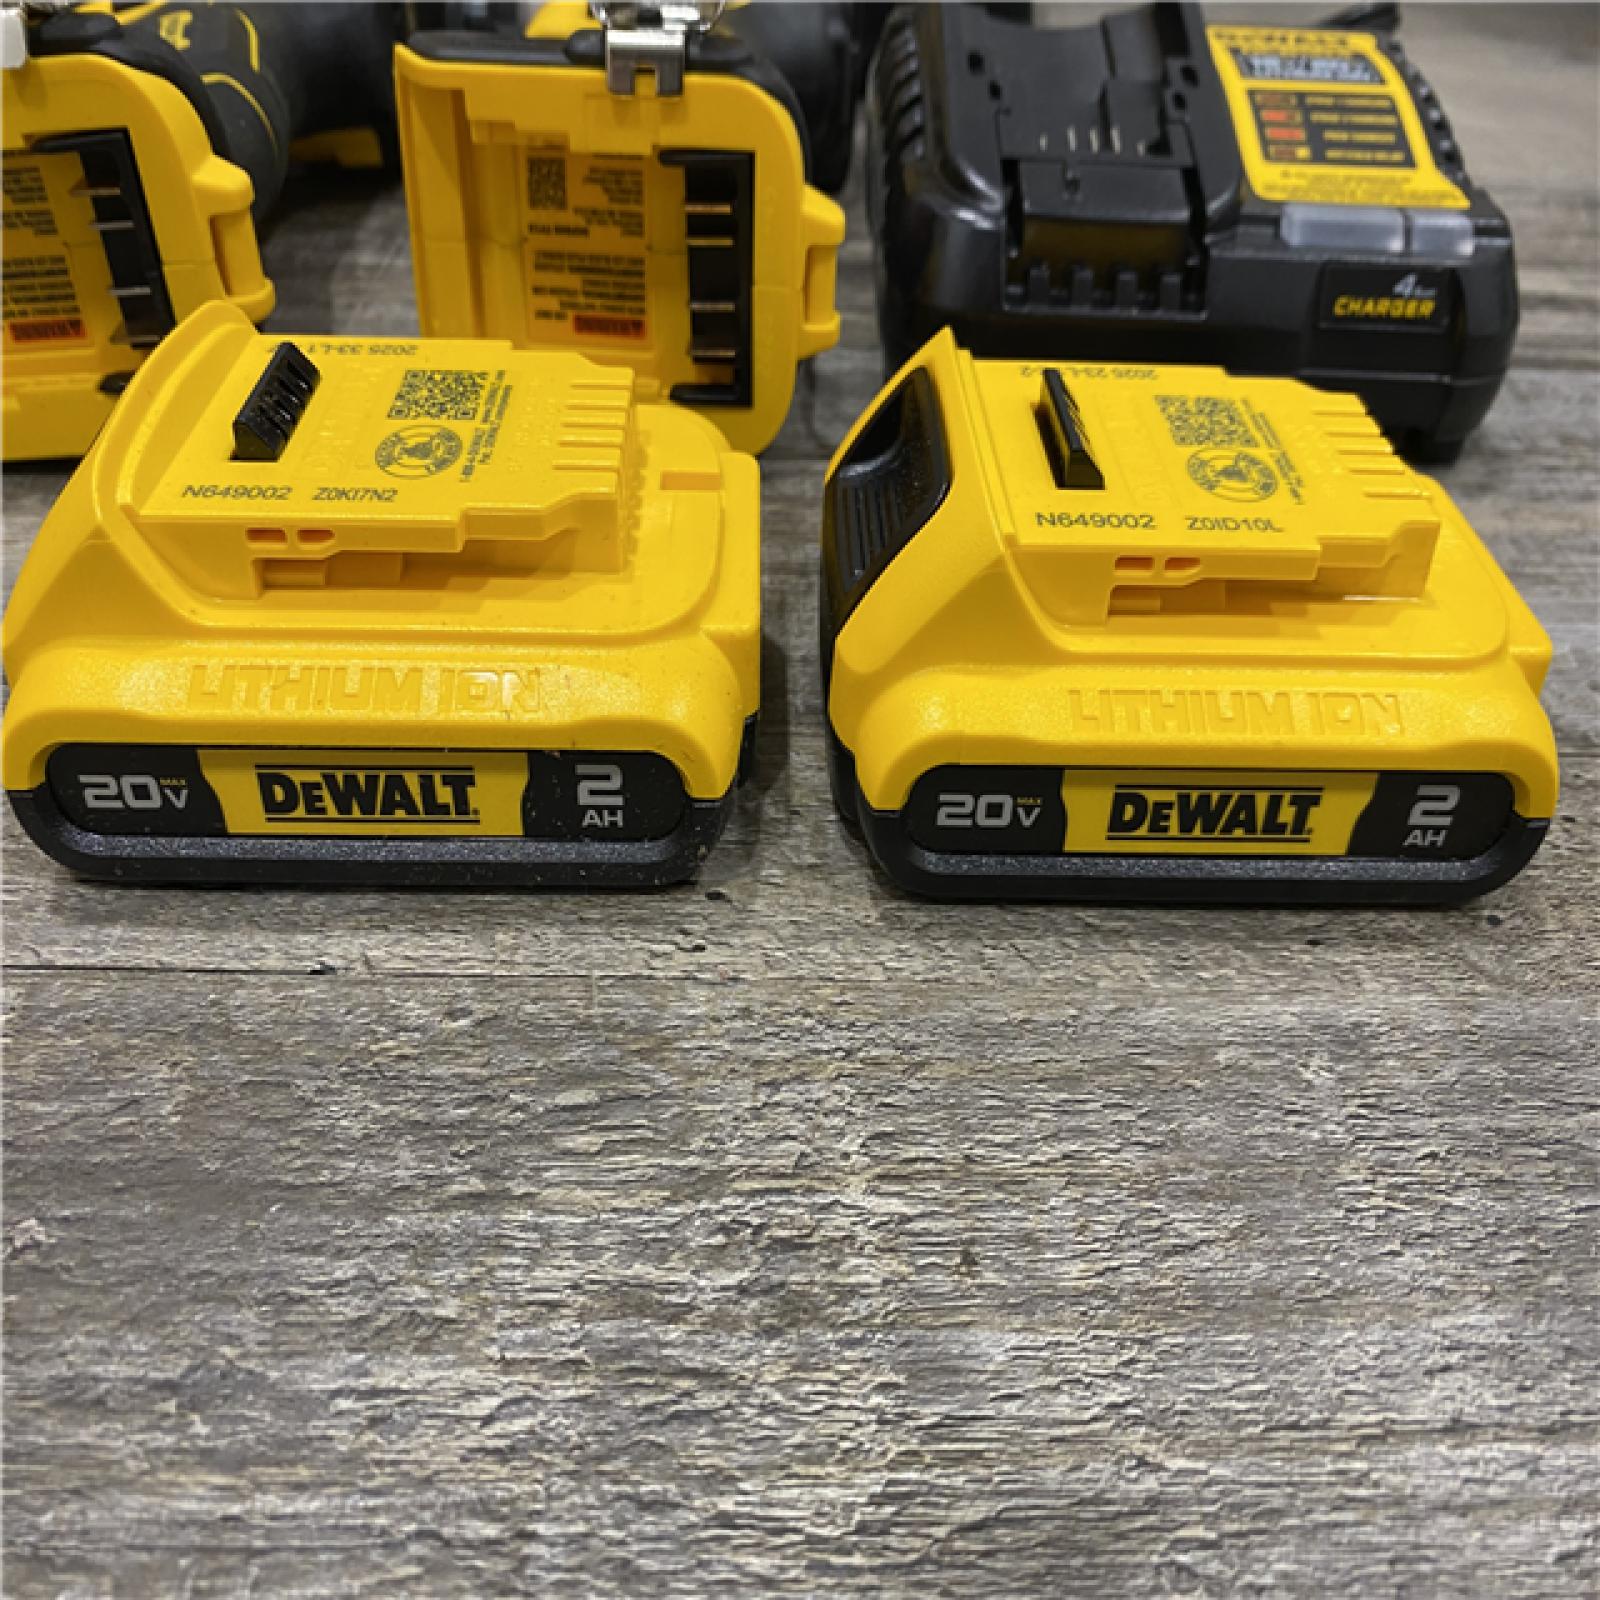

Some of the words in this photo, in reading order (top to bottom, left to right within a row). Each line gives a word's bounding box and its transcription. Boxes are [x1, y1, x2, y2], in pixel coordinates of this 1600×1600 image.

[1333, 295, 1437, 320] CHARGER
[181, 484, 294, 501] N649002
[1035, 511, 1158, 529] N649002
[188, 664, 425, 713] LITHIUM
[439, 666, 542, 713] ION
[1068, 689, 1292, 735] LITHIUM
[1307, 692, 1404, 737] ION
[256, 772, 478, 817] DEWALT
[575, 764, 624, 807] 2
[1408, 785, 1461, 826] 2
[581, 810, 624, 828] AH
[1106, 791, 1323, 837] DEWALT
[1403, 829, 1447, 848] AH
